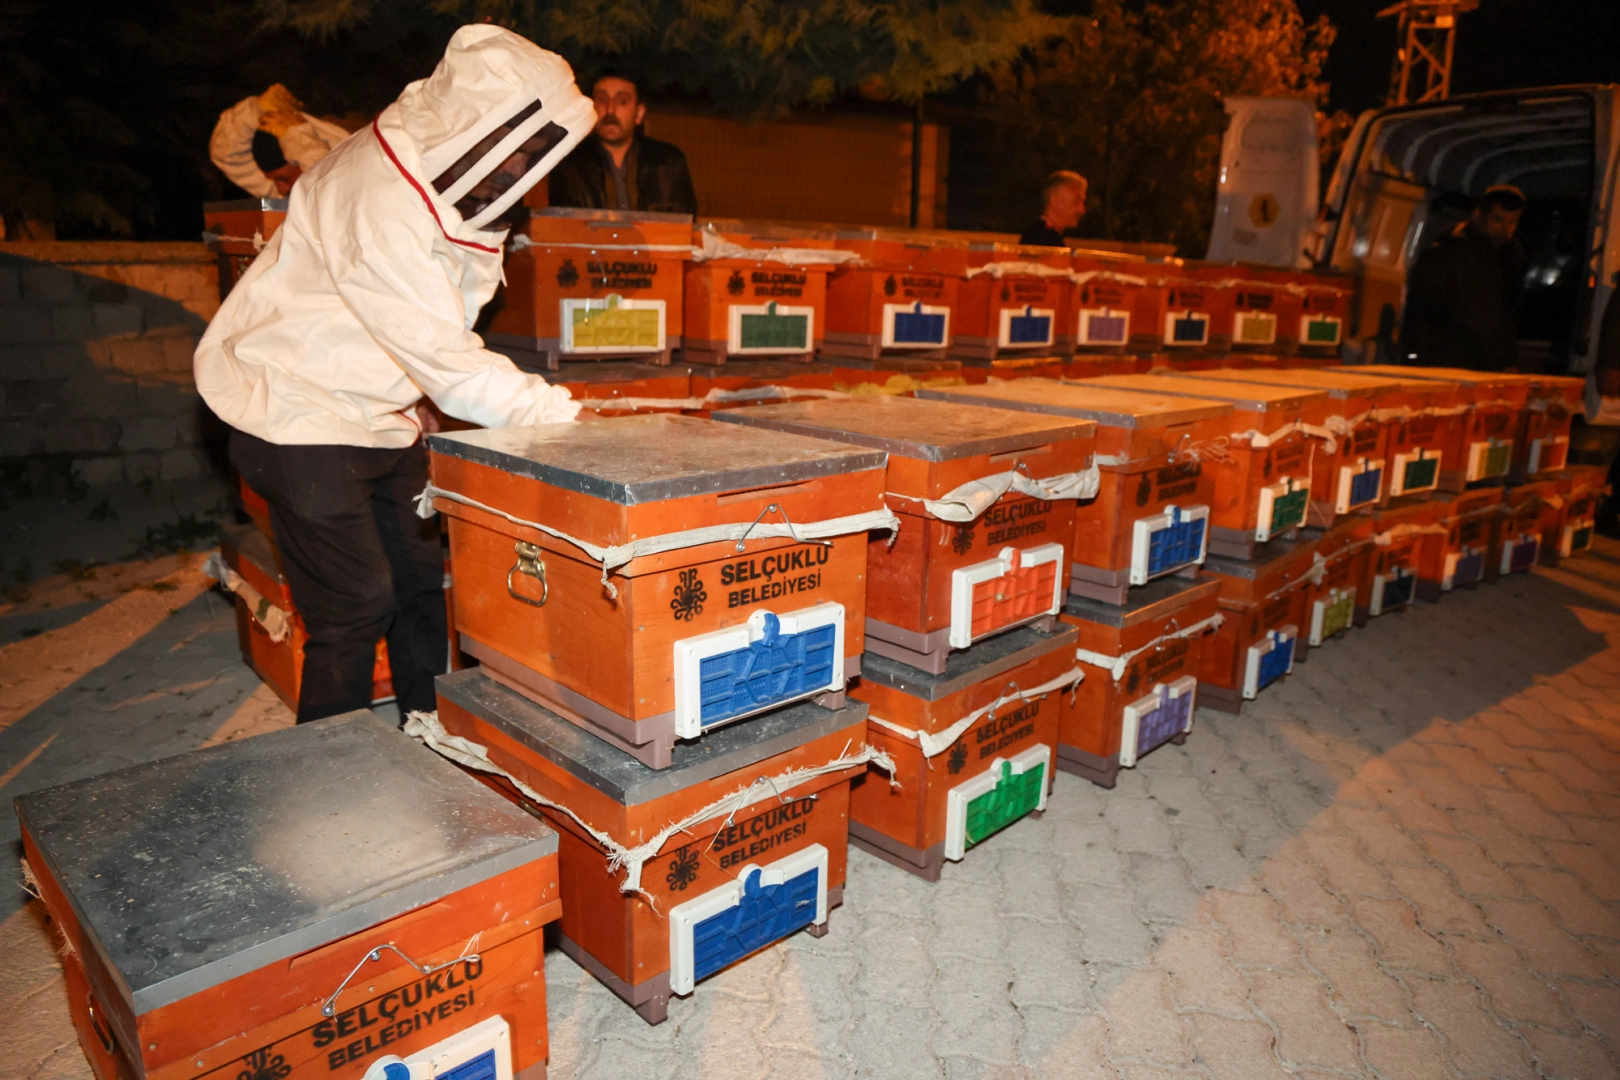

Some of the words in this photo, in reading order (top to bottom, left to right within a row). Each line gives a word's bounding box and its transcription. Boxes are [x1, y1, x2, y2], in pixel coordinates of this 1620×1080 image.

[984, 500, 1052, 528] SELÇUKLU
[720, 545, 830, 586] SELÇUKLU
[728, 569, 821, 609] BELEDİYESİ
[712, 799, 815, 853] SELÇUKLU
[719, 821, 807, 870] BELEDİYESİ
[312, 957, 483, 1048] SELÇUKLU
[328, 985, 475, 1072] BELEDİYESİ
